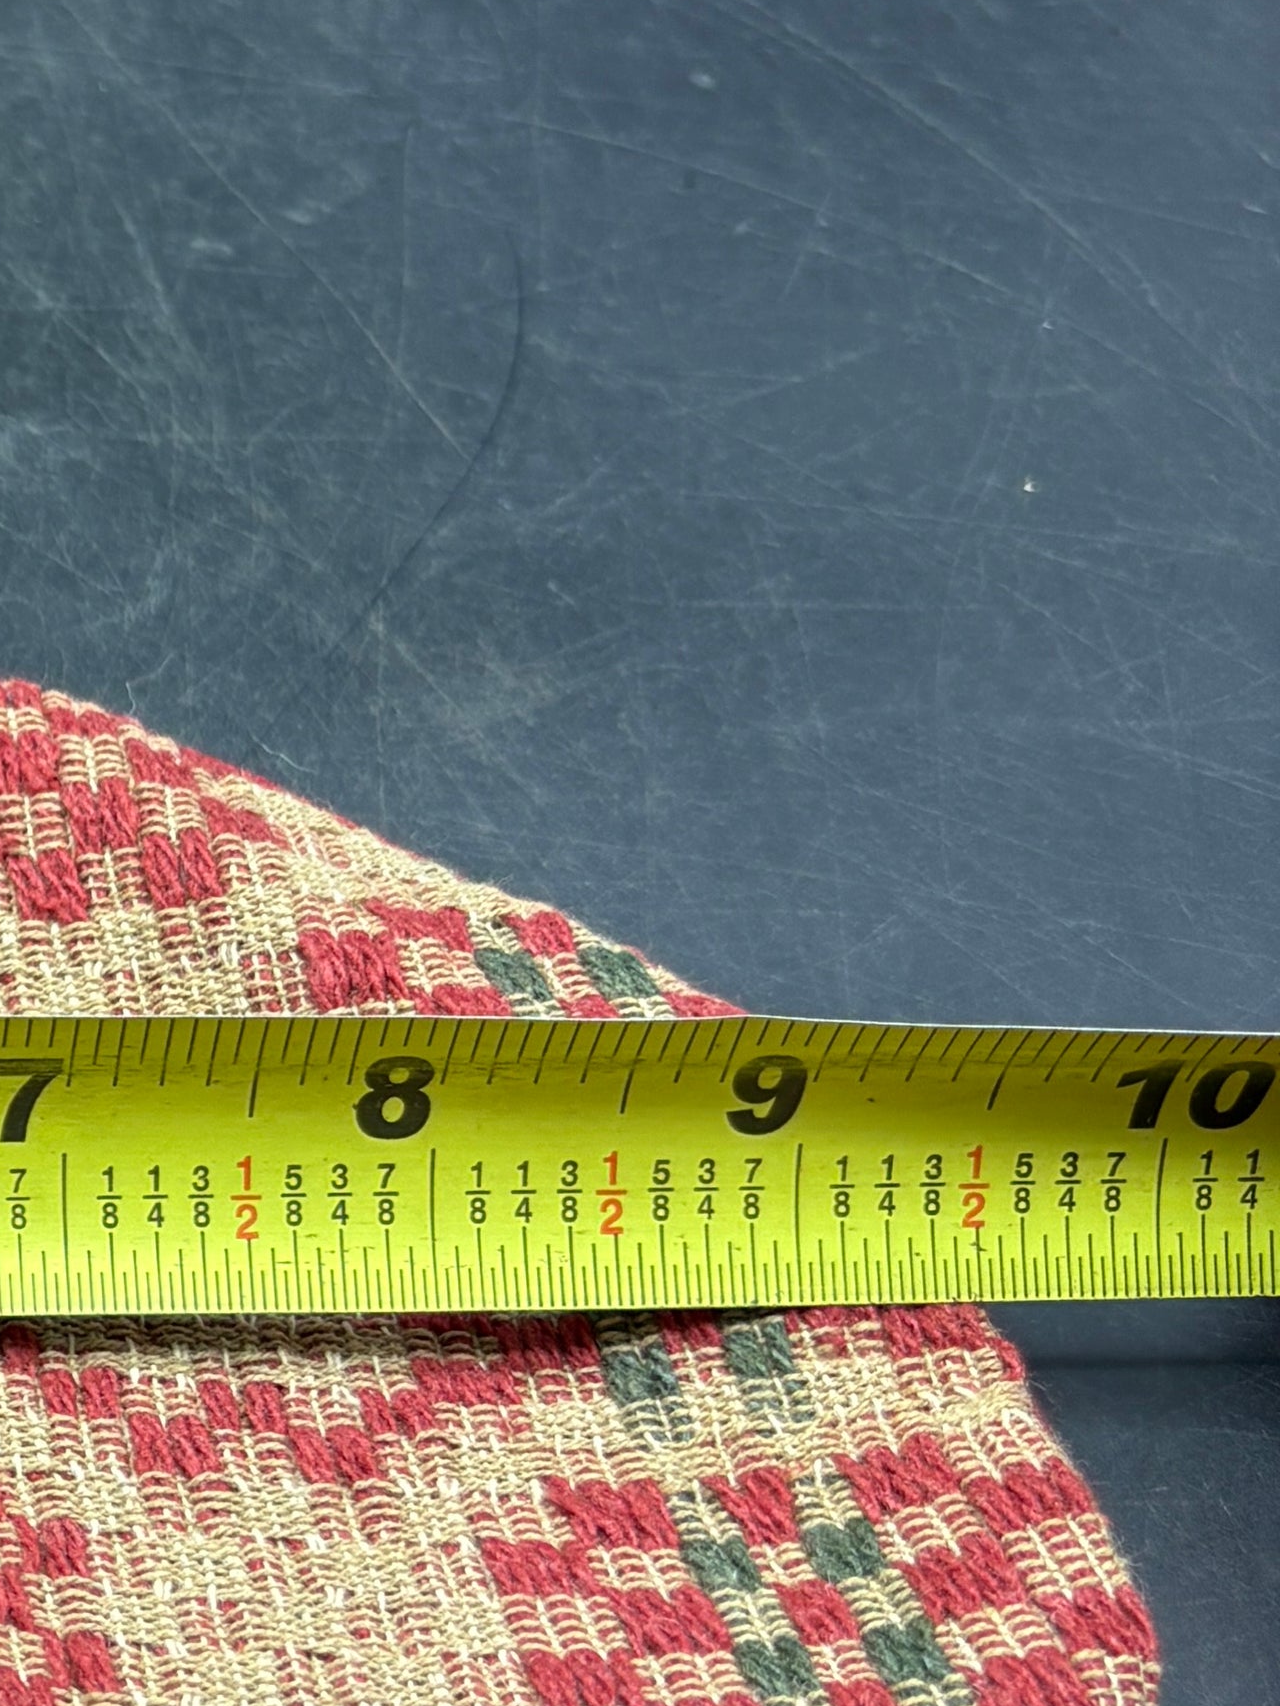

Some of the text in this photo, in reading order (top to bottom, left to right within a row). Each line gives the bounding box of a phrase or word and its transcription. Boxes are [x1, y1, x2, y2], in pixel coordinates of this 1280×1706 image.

[353, 1055, 436, 1140] 8
[726, 1054, 809, 1135] 9
[1116, 1059, 1277, 1129] 10
